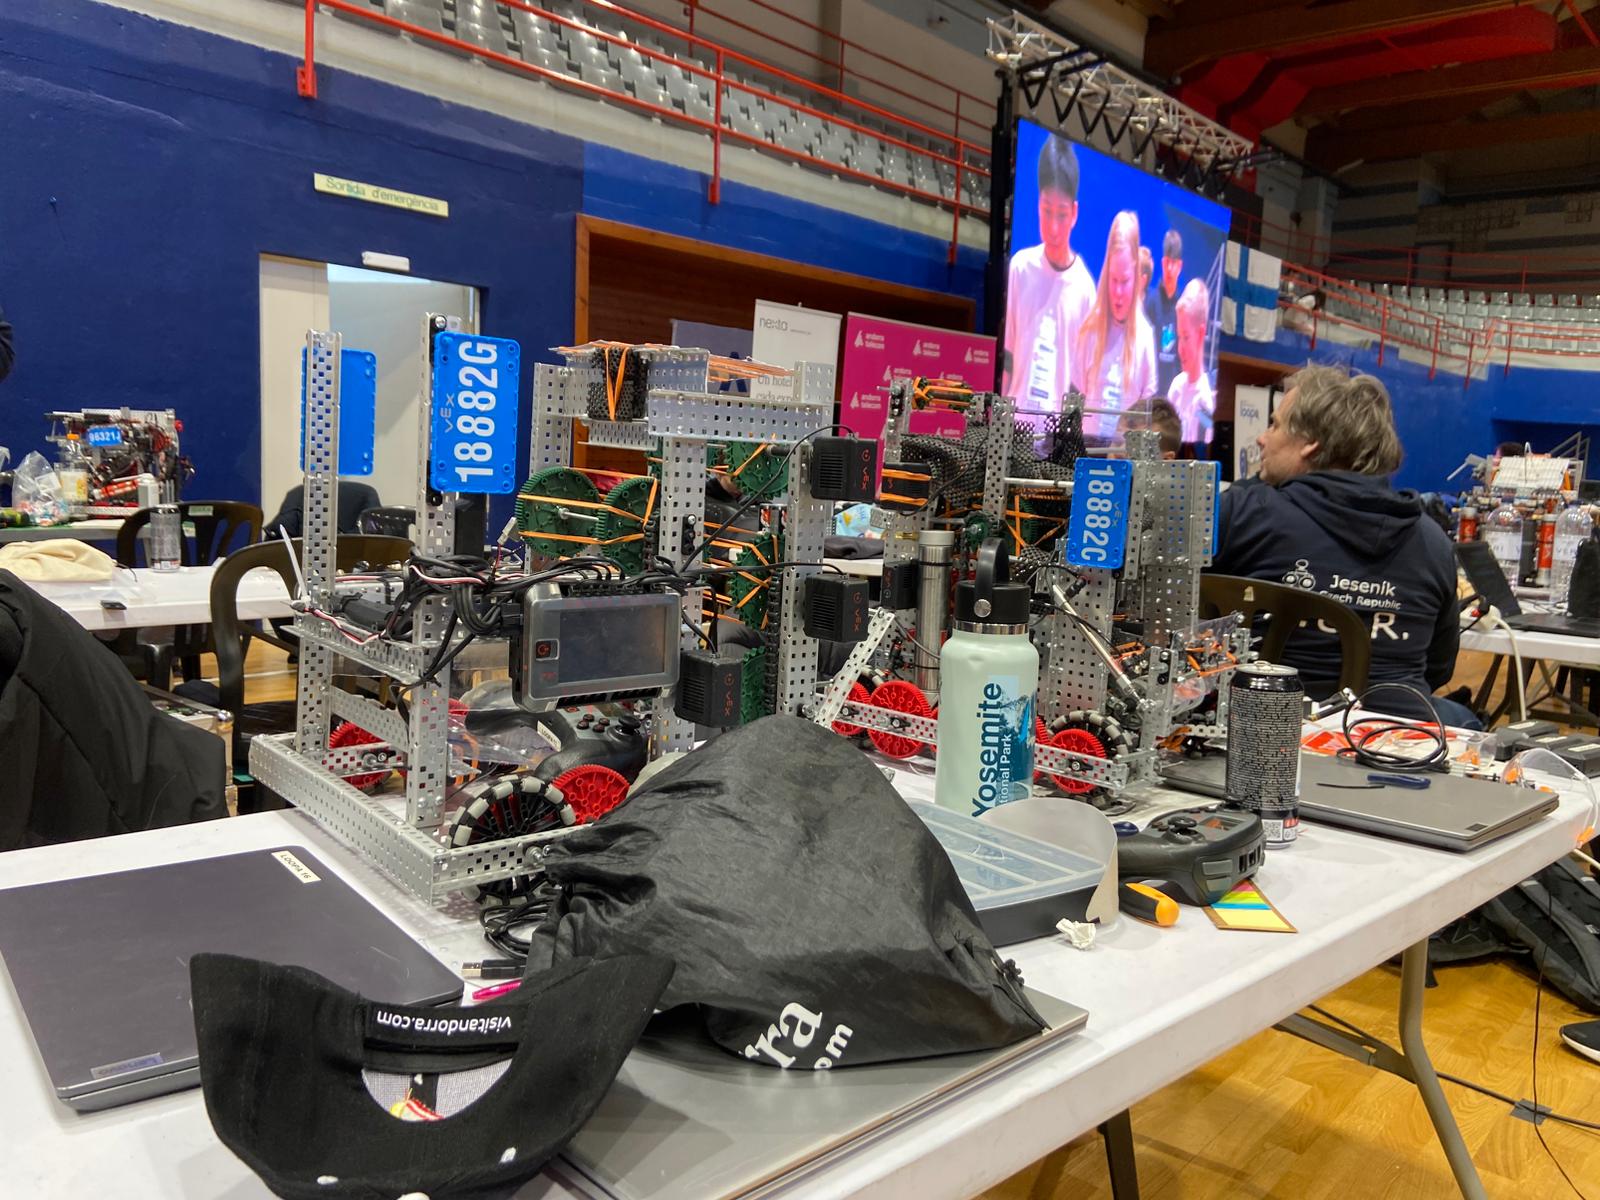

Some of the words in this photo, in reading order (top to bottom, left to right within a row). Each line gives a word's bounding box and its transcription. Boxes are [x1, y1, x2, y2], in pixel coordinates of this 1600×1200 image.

[326, 176, 366, 195] Sortida
[454, 341, 498, 483] 18882G
[1081, 464, 1115, 562] 18882C
[1356, 595, 1402, 610] Republic
[971, 682, 1003, 818] Yosemite
[1000, 733, 1012, 764] Park
[376, 1010, 512, 1036] visitandorra.com
